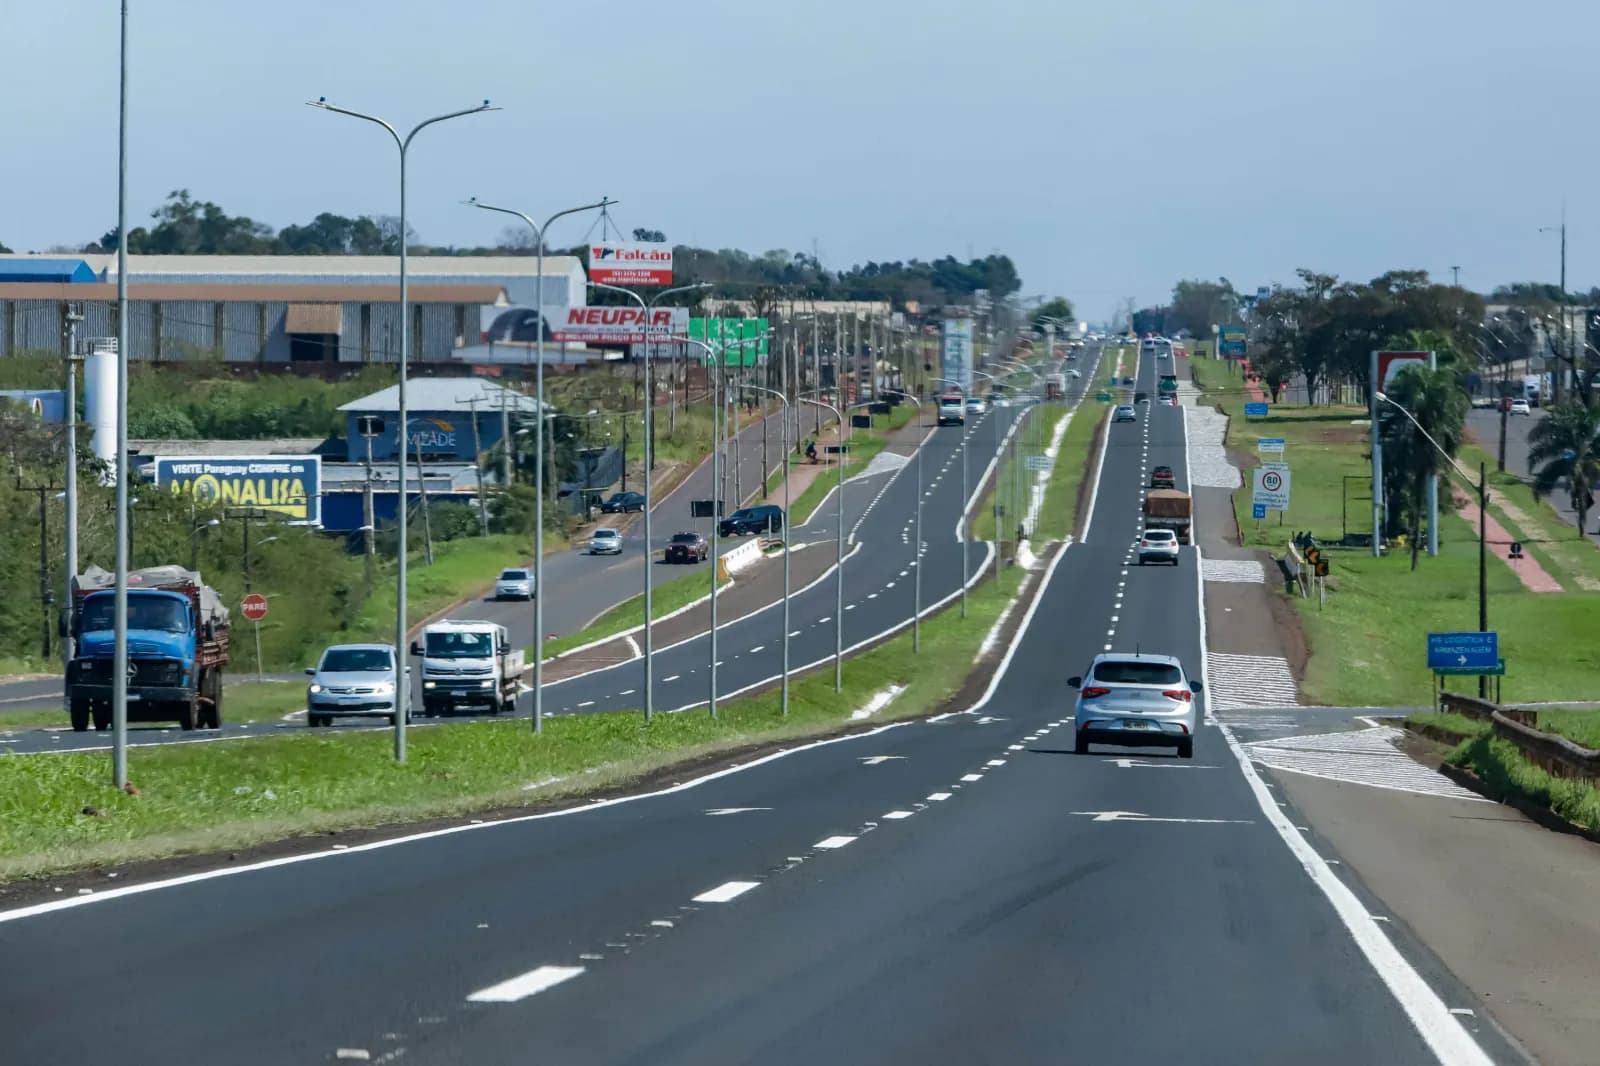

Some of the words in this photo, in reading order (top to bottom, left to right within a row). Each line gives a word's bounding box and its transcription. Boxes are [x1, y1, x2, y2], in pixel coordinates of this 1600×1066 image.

[567, 308, 672, 326] NEUPAR
[172, 464, 203, 474] VISITE
[204, 464, 247, 475] Paraguay
[249, 464, 290, 473] COMPRE
[1266, 476, 1278, 484] 80
[242, 603, 266, 611] PARE
